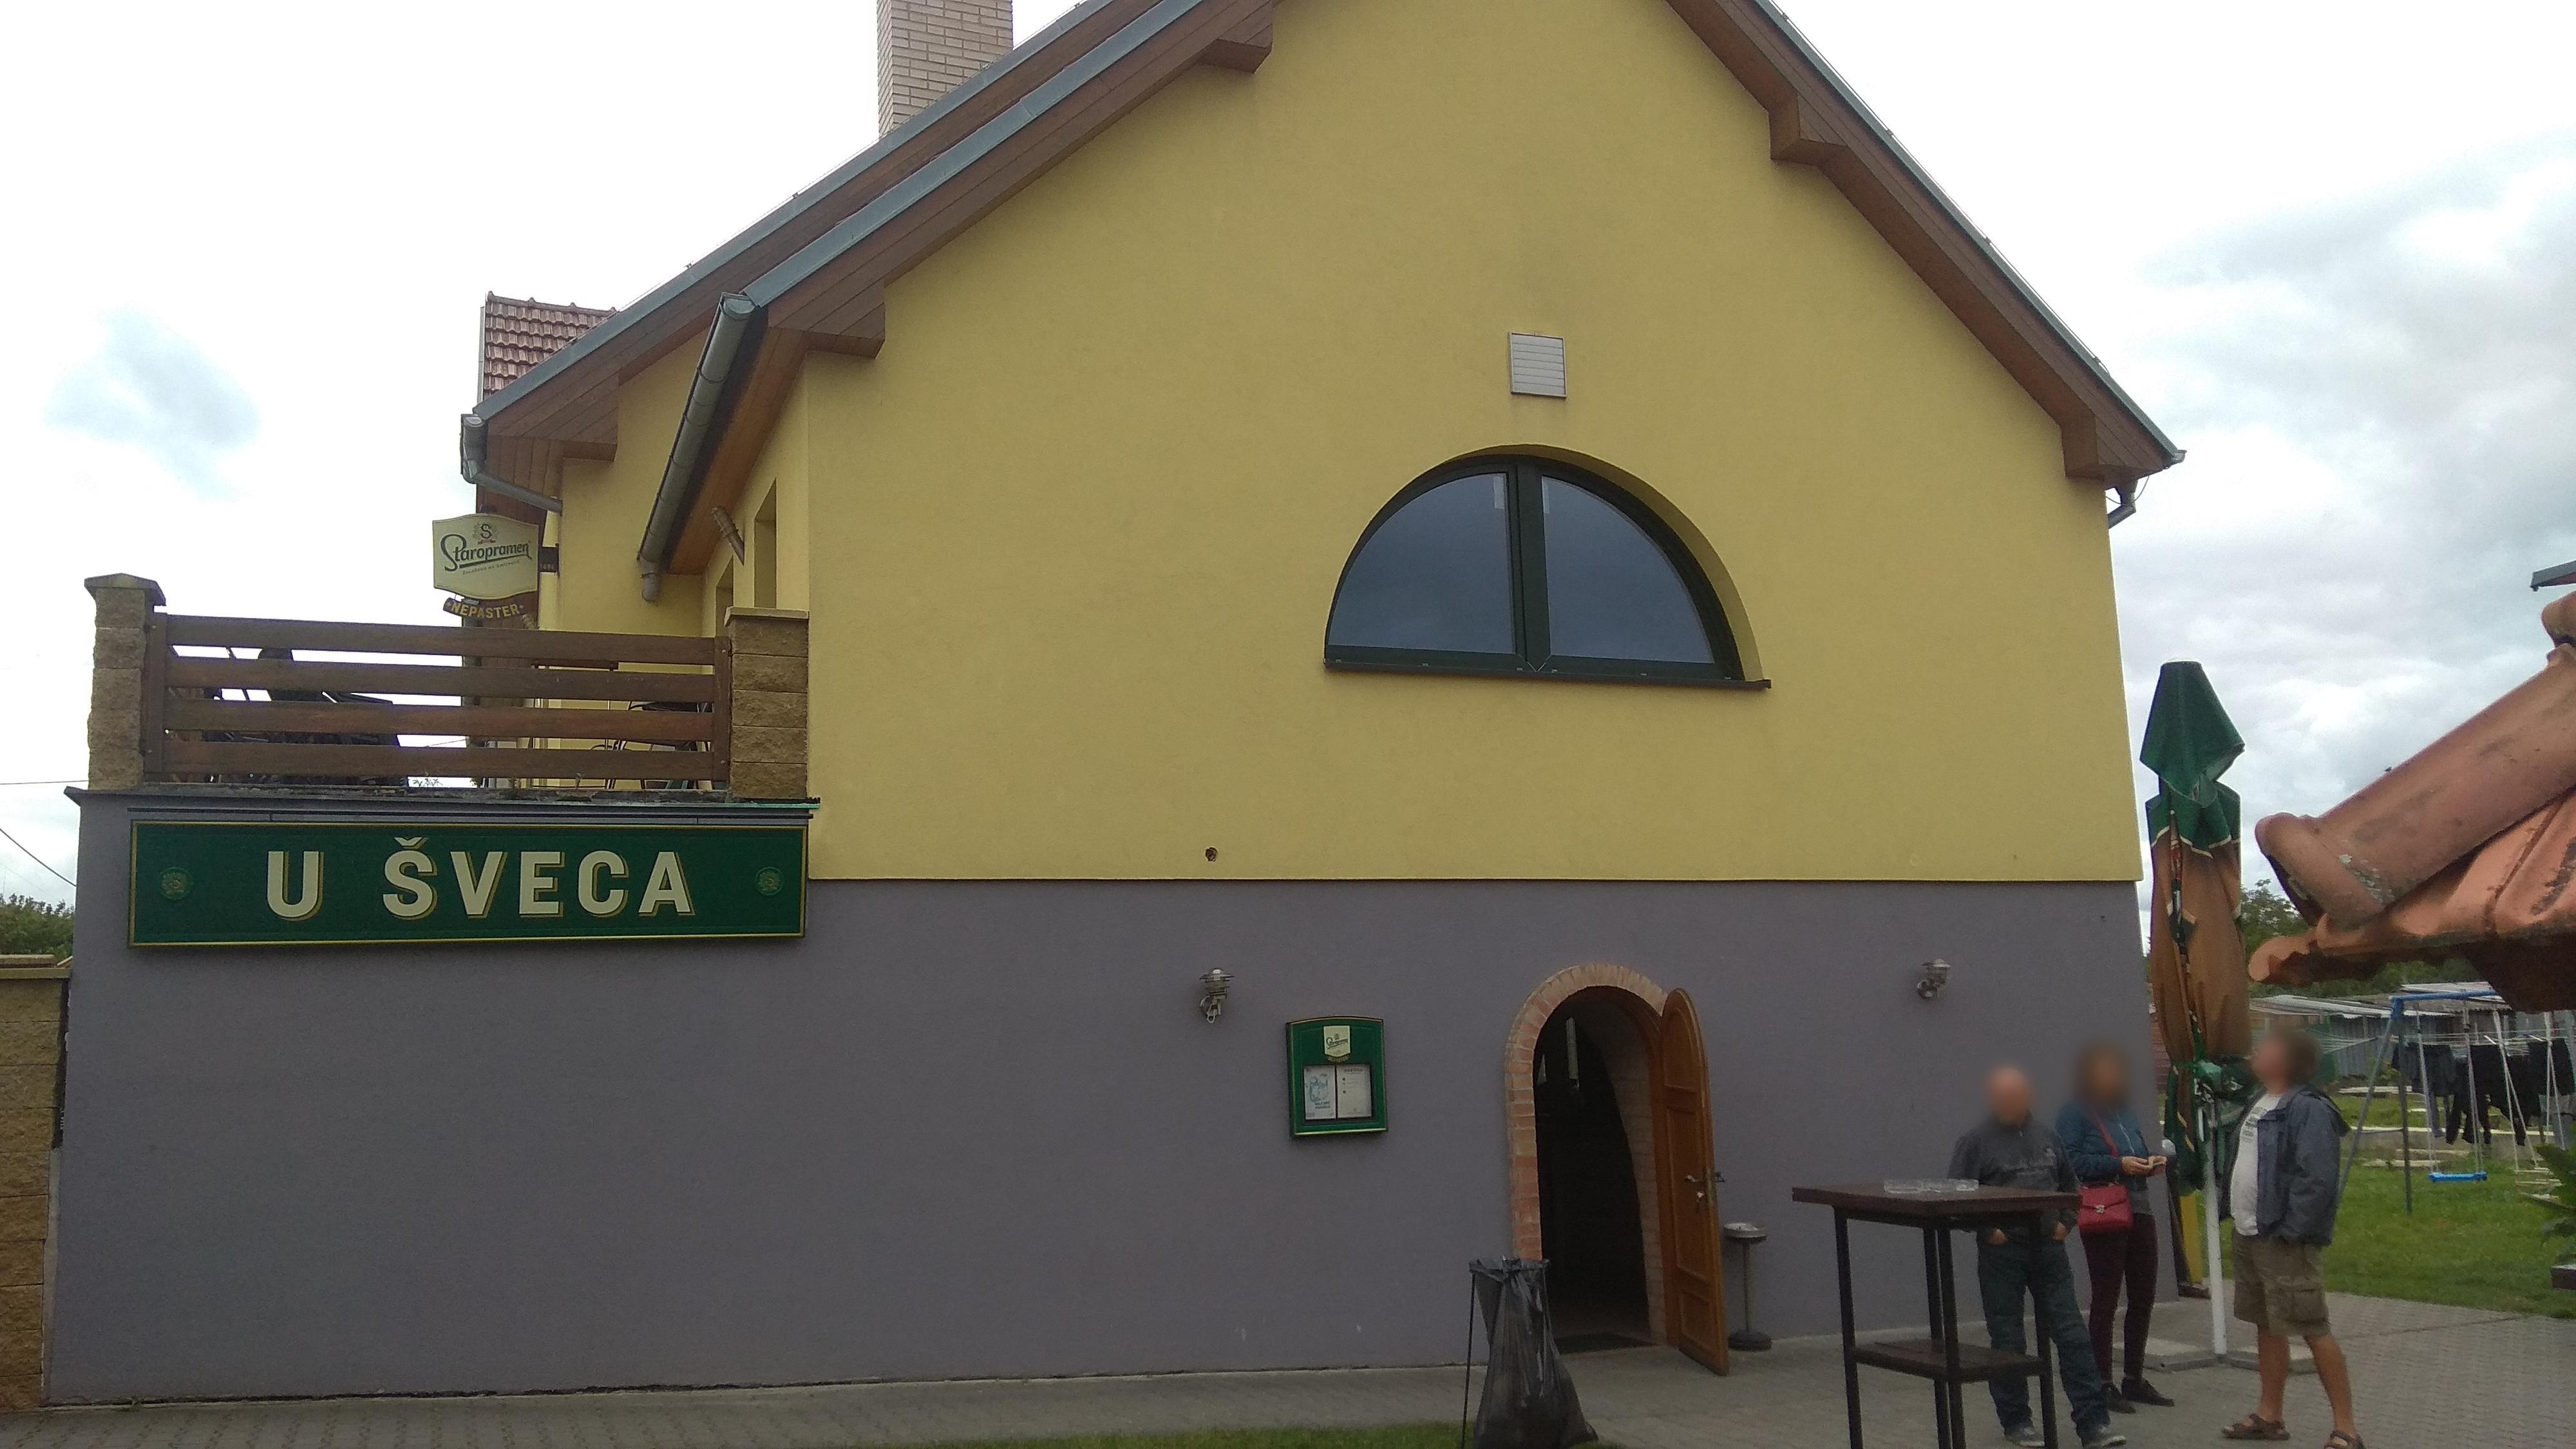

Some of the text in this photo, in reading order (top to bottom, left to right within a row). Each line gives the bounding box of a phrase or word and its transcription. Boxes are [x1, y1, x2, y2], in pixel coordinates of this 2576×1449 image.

[480, 524, 492, 539] S
[440, 534, 530, 572] Staropramen
[451, 602, 520, 619] NEPASTER
[266, 837, 695, 921] U ŠVECA
